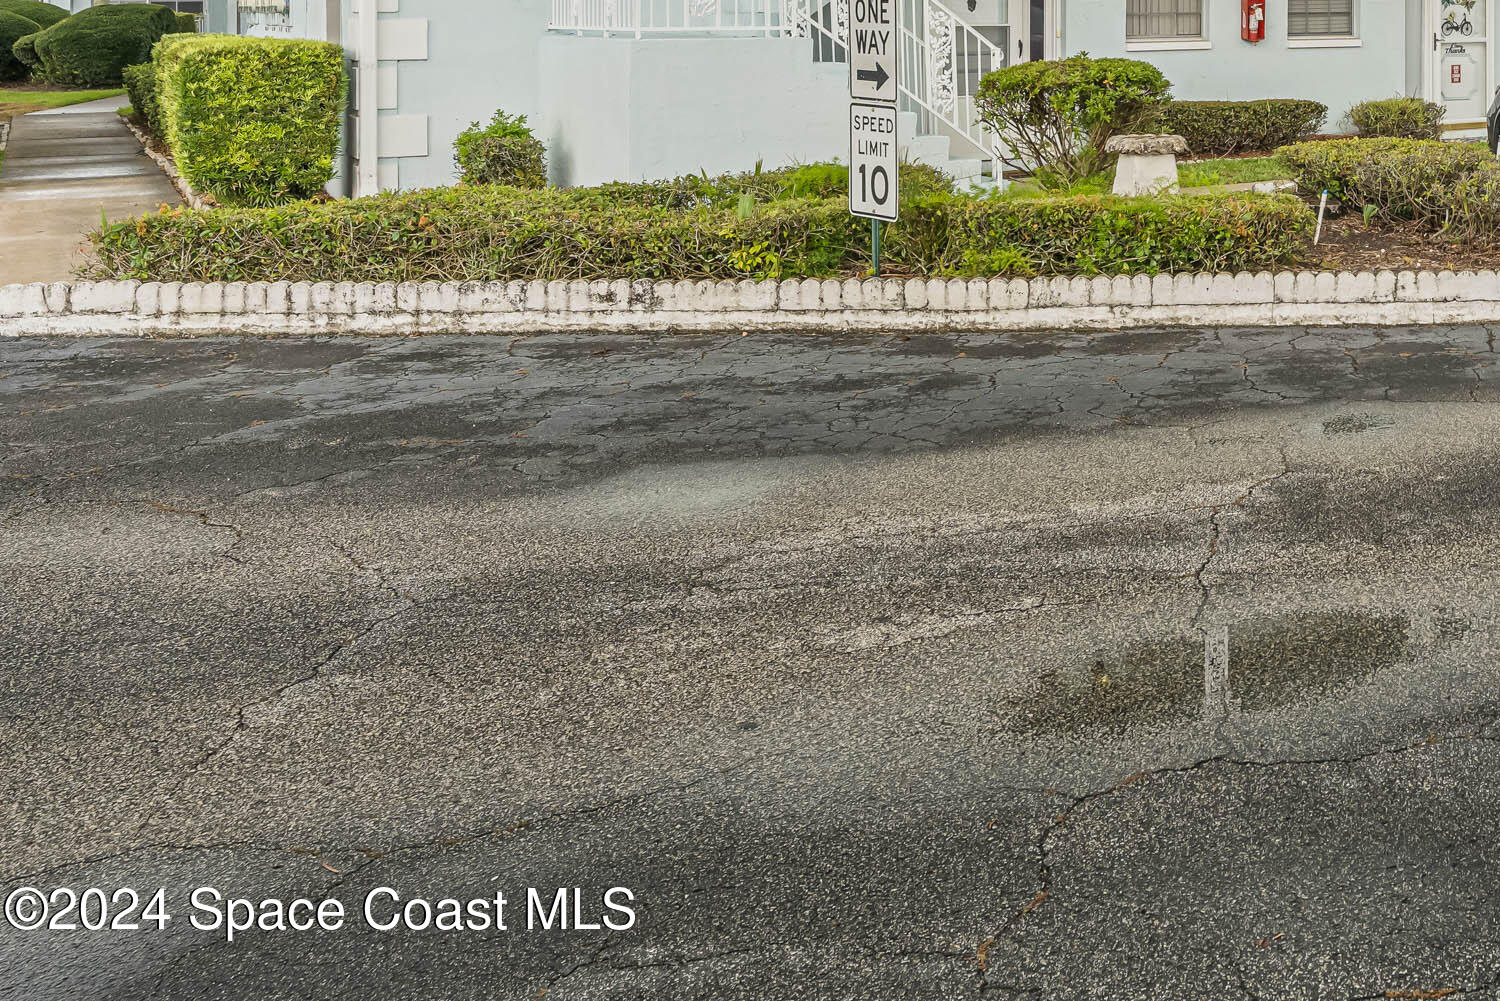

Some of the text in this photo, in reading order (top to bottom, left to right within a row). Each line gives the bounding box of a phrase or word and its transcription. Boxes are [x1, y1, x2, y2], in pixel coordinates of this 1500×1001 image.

[855, 29, 890, 56] WAY
[853, 115, 894, 134] SPEED
[858, 139, 889, 158] LIMIT
[858, 163, 889, 206] 10
